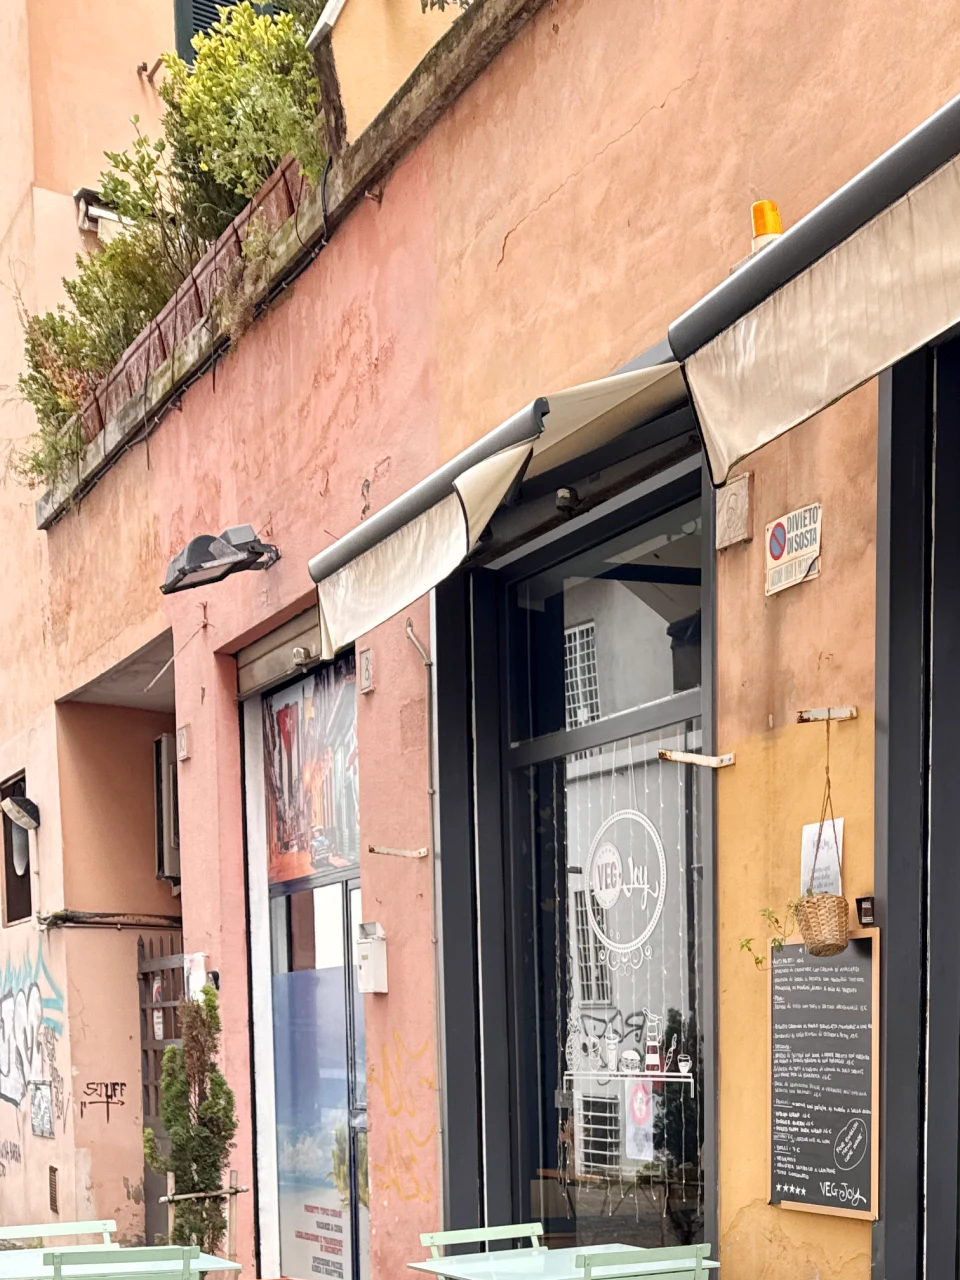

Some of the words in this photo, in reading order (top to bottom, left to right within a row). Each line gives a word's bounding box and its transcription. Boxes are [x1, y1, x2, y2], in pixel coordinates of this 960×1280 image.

[726, 493, 739, 529] 6
[787, 505, 819, 534] DIVIETO
[787, 536, 794, 555] DI
[794, 527, 817, 552] SOSTA
[597, 862, 617, 890] VEG
[620, 856, 660, 910] Joy
[819, 1181, 838, 1197] VEG
